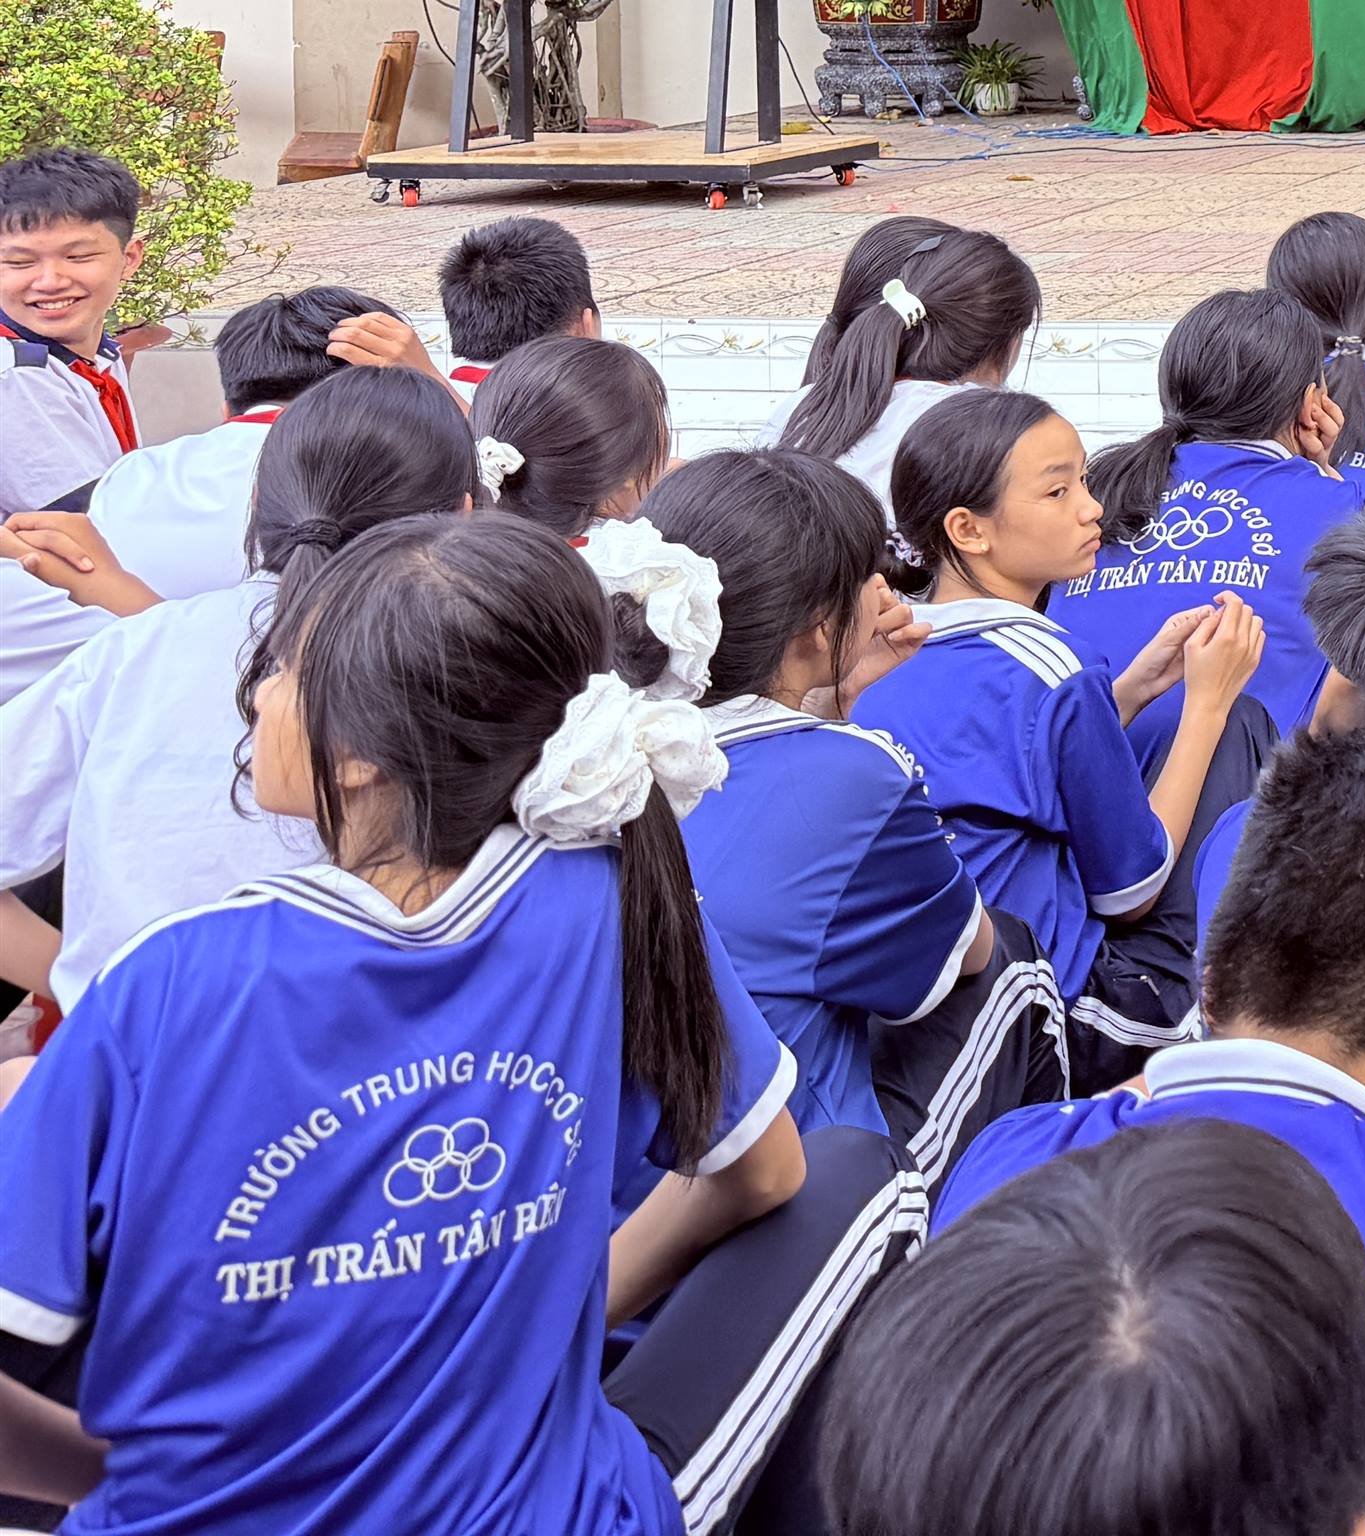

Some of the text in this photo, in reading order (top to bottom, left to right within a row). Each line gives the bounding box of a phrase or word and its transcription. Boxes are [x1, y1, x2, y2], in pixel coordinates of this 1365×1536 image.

[1160, 478, 1282, 557] RUNG HỌC CƠ SỞ
[1097, 553, 1154, 591] TRẤN
[1157, 553, 1207, 584] TÂN
[1209, 556, 1270, 590] BIÊN
[213, 1106, 343, 1244] TRƯỜNG
[341, 1051, 475, 1117] TRUNG
[486, 1050, 556, 1093] HỌC
[543, 1079, 587, 1123] CƠ
[215, 1256, 296, 1304] THỊ
[307, 1218, 426, 1287] TRẤN
[438, 1209, 507, 1265] TÂN
